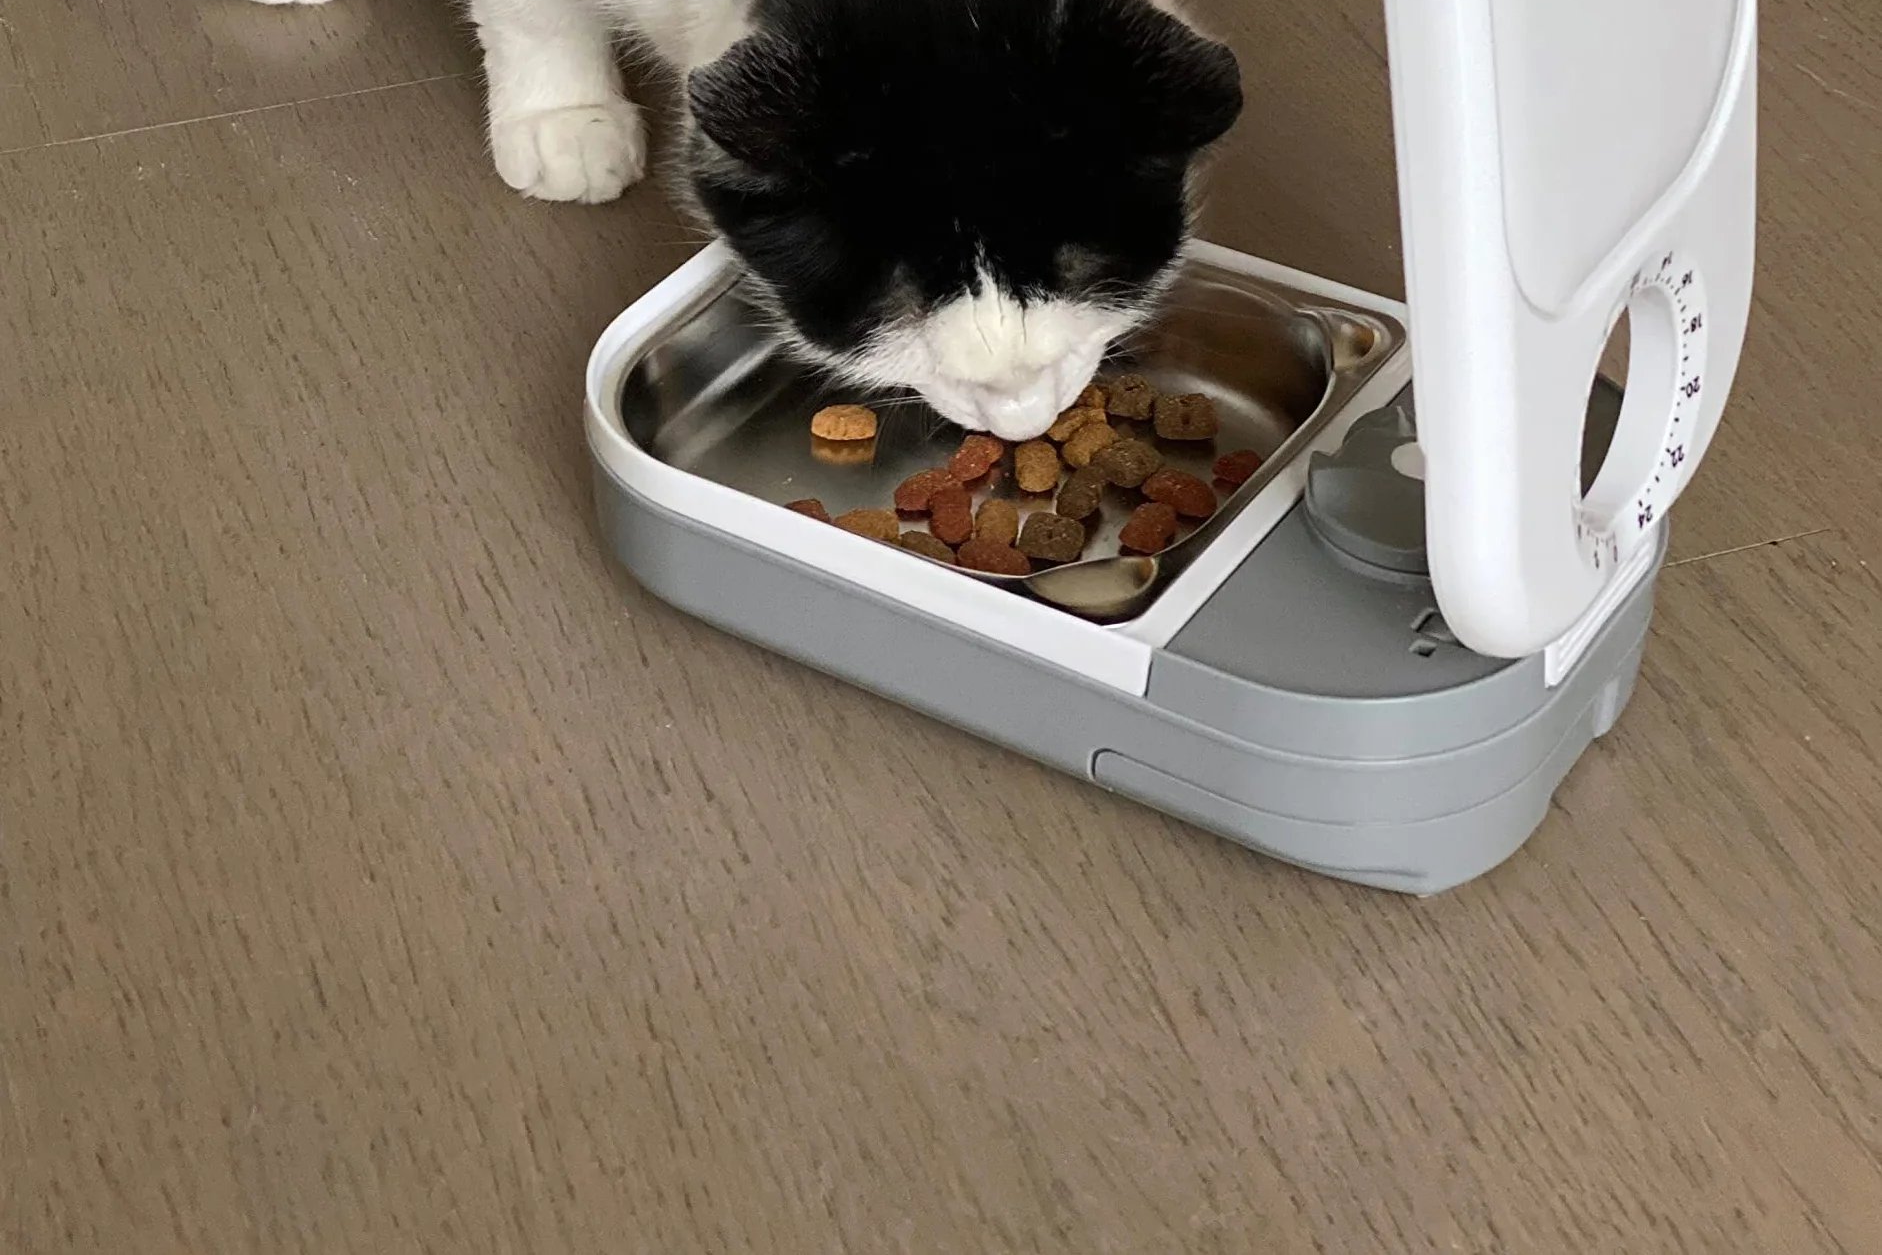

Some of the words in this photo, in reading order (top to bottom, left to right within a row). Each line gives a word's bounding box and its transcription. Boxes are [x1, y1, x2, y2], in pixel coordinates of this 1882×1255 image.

[1690, 312, 1702, 333] 18
[1686, 375, 1701, 398] 20
[1670, 444, 1684, 467] 22
[1638, 504, 1652, 529] 24
